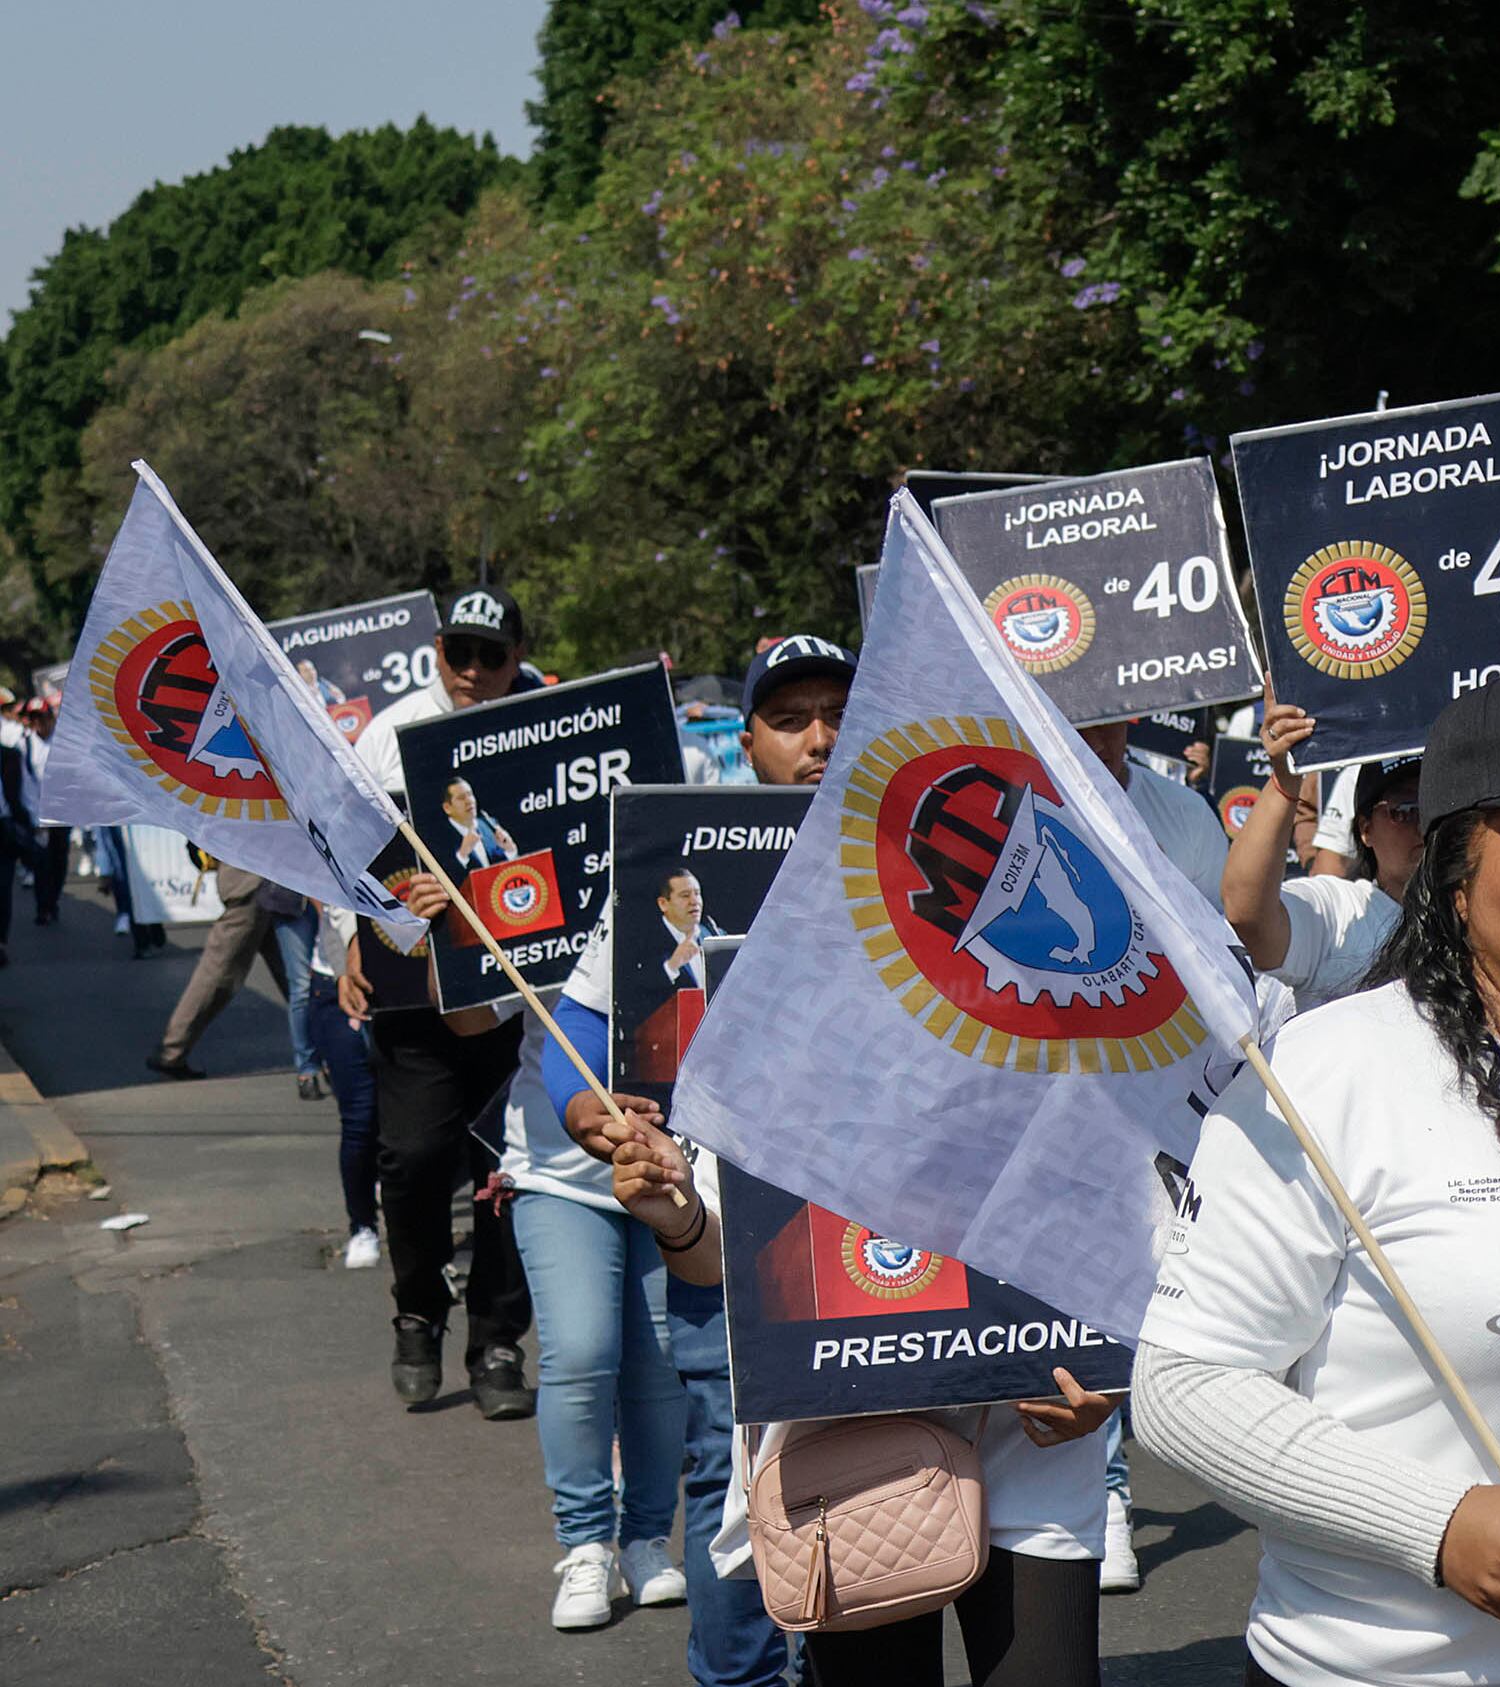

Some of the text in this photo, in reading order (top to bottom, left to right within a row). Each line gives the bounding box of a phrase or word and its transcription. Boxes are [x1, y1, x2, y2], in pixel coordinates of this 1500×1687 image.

[1319, 422, 1491, 479] ¡JORNADA
[1004, 487, 1145, 531] ¡JORNADA
[1026, 512, 1157, 550] LABORAL
[1438, 549, 1471, 571] de
[1104, 556, 1218, 618] de 40
[1320, 567, 1382, 596] CTM
[452, 591, 505, 620] CTM
[283, 609, 410, 652] ¡AGUINALDO
[381, 645, 438, 694] 30
[767, 634, 846, 670] CTM
[1117, 646, 1237, 687] HORAS!
[452, 704, 621, 769] ¡DISMINUCIÓN!
[520, 749, 631, 814] del ISR
[567, 823, 586, 845] al
[681, 826, 797, 856] ¡DISMIN
[578, 888, 592, 909] y
[1450, 1195, 1487, 1204] Grupos
[812, 1319, 1119, 1371] PRESTACIONE
